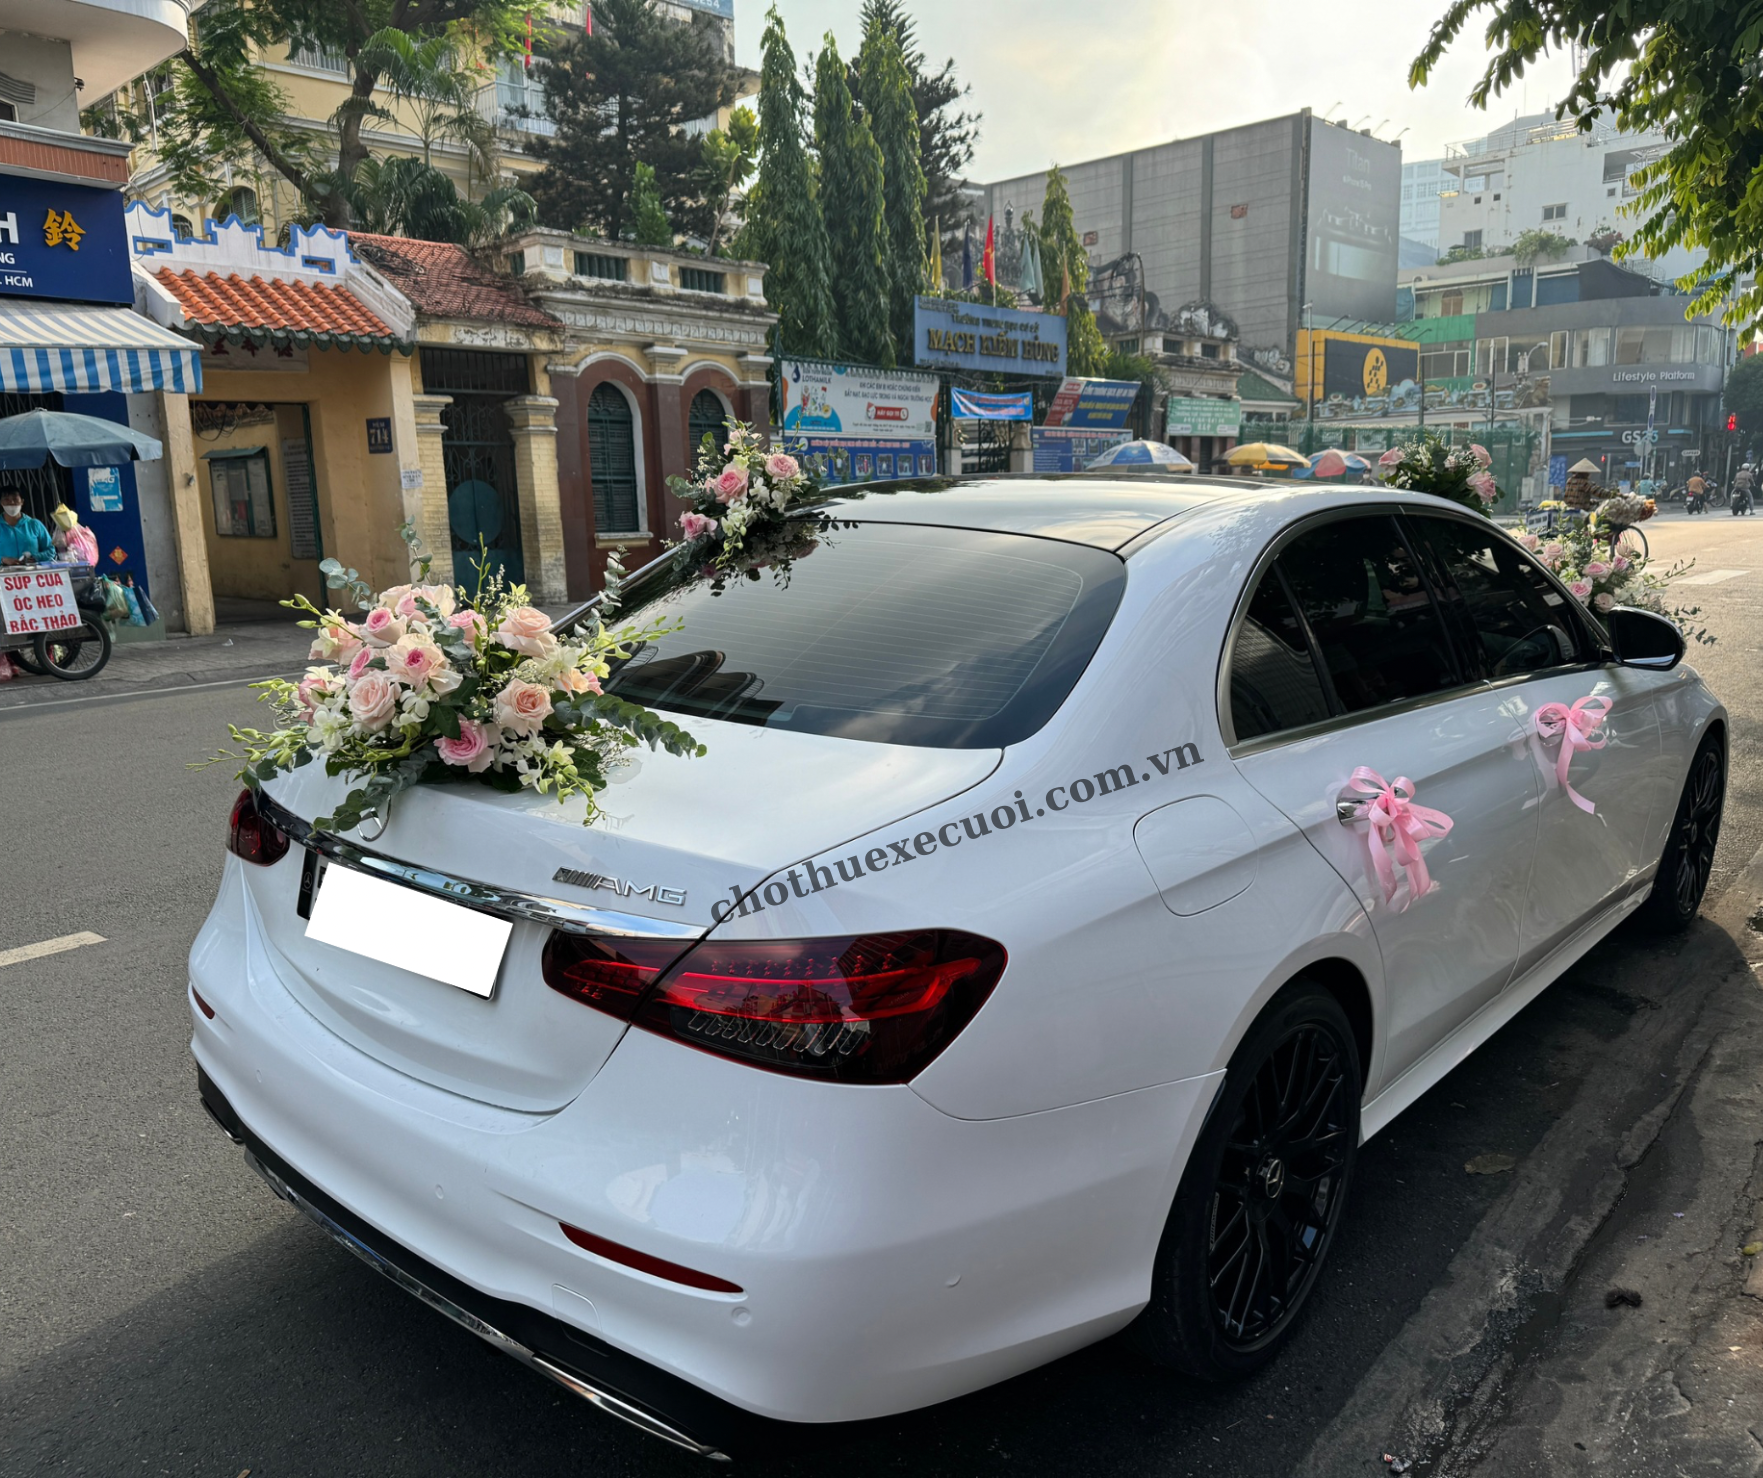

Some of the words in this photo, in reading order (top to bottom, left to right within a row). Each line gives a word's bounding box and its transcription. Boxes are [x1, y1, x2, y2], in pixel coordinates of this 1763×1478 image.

[43, 208, 86, 251] 鈴
[4, 275, 33, 288] HCM
[927, 328, 976, 356] MẠCH
[980, 331, 1018, 359] KIẾM
[802, 375, 832, 384] LOTHAMILK
[1613, 372, 1656, 383] Lifestyle
[1660, 371, 1695, 380] Platform
[369, 428, 389, 445] 714
[4, 574, 31, 591] SÚP
[35, 573, 64, 588] CUA
[13, 595, 33, 611] ÓC
[36, 594, 64, 609] HEO
[9, 614, 39, 633] BẮC
[41, 610, 77, 630] THẢO
[592, 874, 688, 906] AMG
